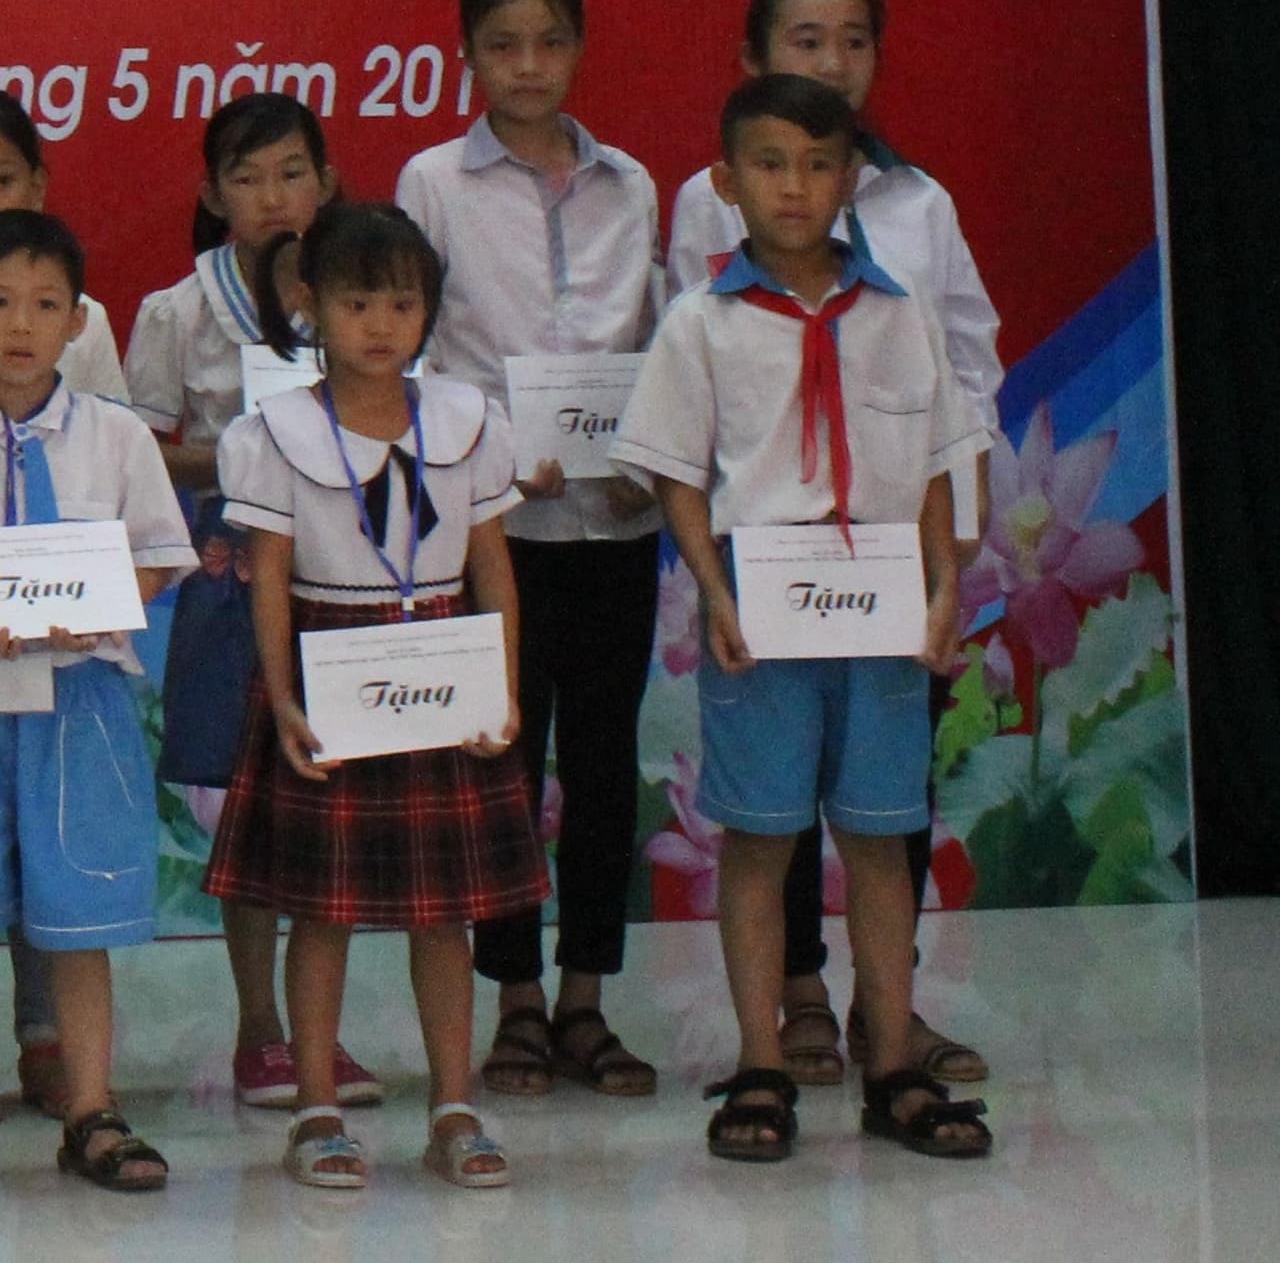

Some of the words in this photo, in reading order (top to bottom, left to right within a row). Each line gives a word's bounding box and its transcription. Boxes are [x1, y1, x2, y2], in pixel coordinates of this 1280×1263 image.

[109, 48, 149, 120] 5
[360, 45, 473, 117] 201
[557, 407, 618, 440] Tặn
[785, 583, 876, 617] Tặng
[359, 681, 456, 713] Tặng
